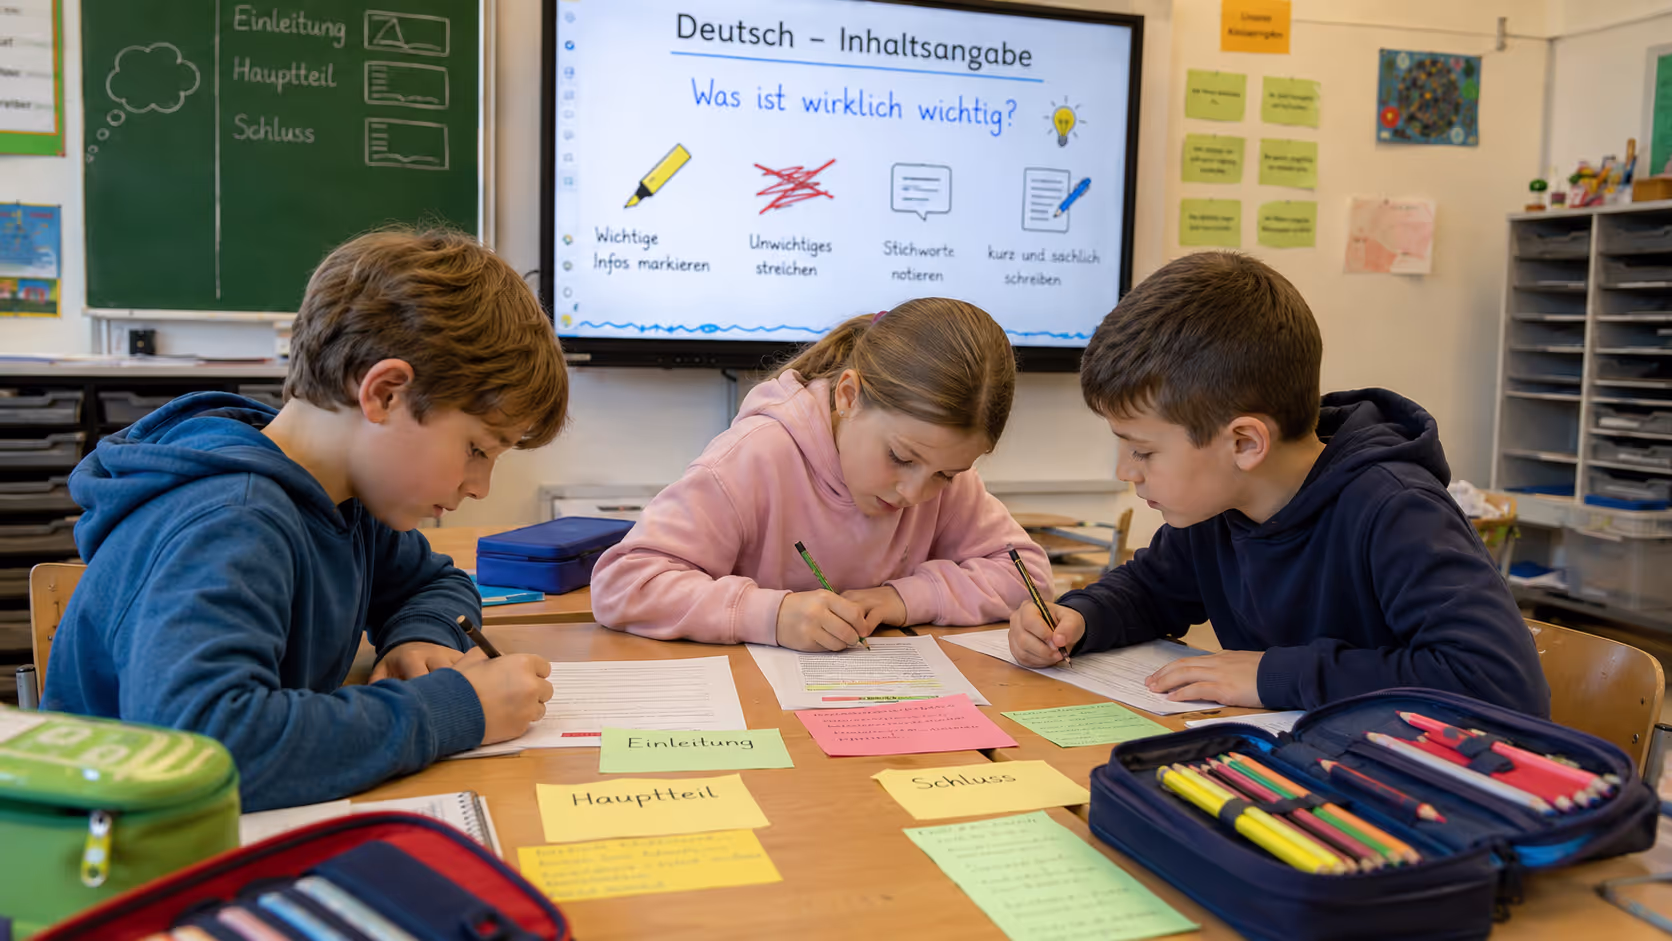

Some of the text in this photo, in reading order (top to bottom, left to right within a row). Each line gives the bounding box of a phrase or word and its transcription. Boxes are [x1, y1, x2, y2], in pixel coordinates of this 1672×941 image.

[234, 5, 346, 48] Einleitung
[678, 14, 793, 47] Deutsch
[840, 26, 1033, 71] Inhaltsangabe
[233, 56, 338, 95] Hauptteil
[692, 78, 1017, 137] Was ist wirklich wichtig?
[232, 113, 316, 144] Schluss
[595, 227, 659, 248] Wichtige
[750, 235, 832, 256] Unwichtiges
[884, 241, 954, 257] Stichworte
[988, 246, 1100, 264] kurz und sachlich
[594, 253, 709, 275] Infos markieren
[757, 262, 817, 276] streichen
[892, 268, 943, 281] notieren
[1005, 272, 1061, 285] schreiben
[628, 737, 754, 750] Einleitung
[911, 771, 1017, 791] Schluss
[571, 785, 720, 809] Hauptteil
